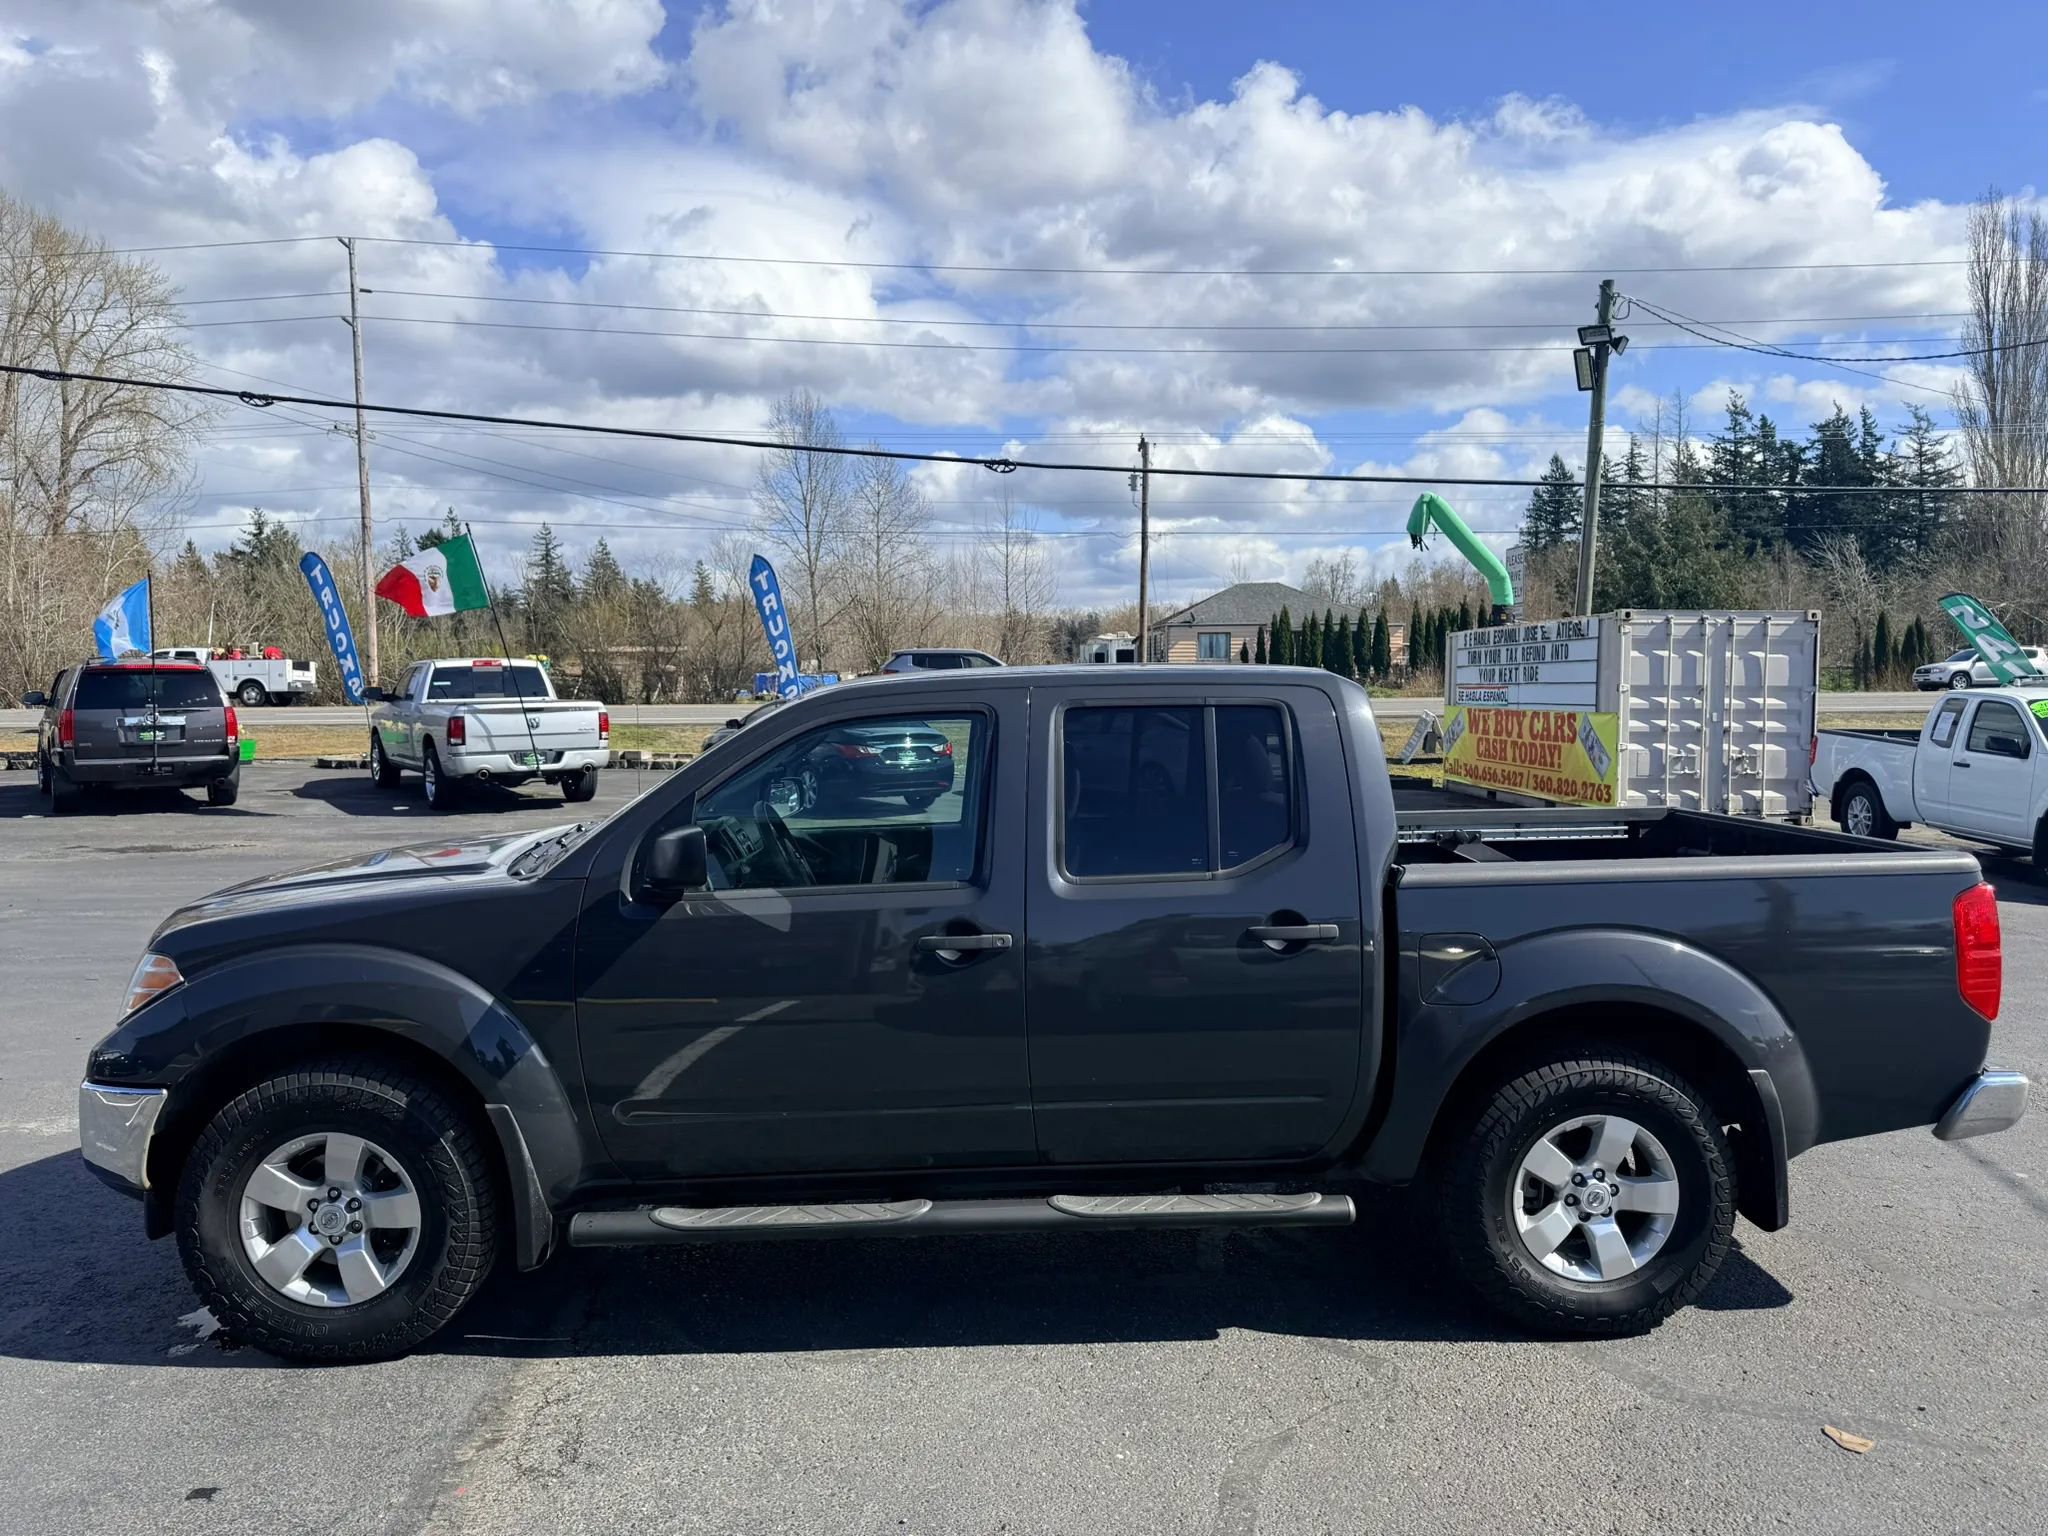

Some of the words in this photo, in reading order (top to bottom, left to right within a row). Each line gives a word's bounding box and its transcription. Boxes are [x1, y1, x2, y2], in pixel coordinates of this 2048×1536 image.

[1467, 650, 1482, 666] TURN
[1484, 649, 1501, 664] YOUR
[1505, 647, 1518, 663] TAX
[1521, 645, 1546, 662] REFUND
[1551, 643, 1569, 661] INTO
[1478, 668, 1496, 684] YOUR
[1498, 666, 1519, 683] NEXT
[1523, 666, 1539, 682] RIDE
[1467, 708, 1490, 737] WE
[1493, 709, 1526, 739] BUY
[1529, 711, 1578, 745] CARS
[1476, 737, 1508, 762] CASH
[1510, 740, 1562, 769] TODAY!
